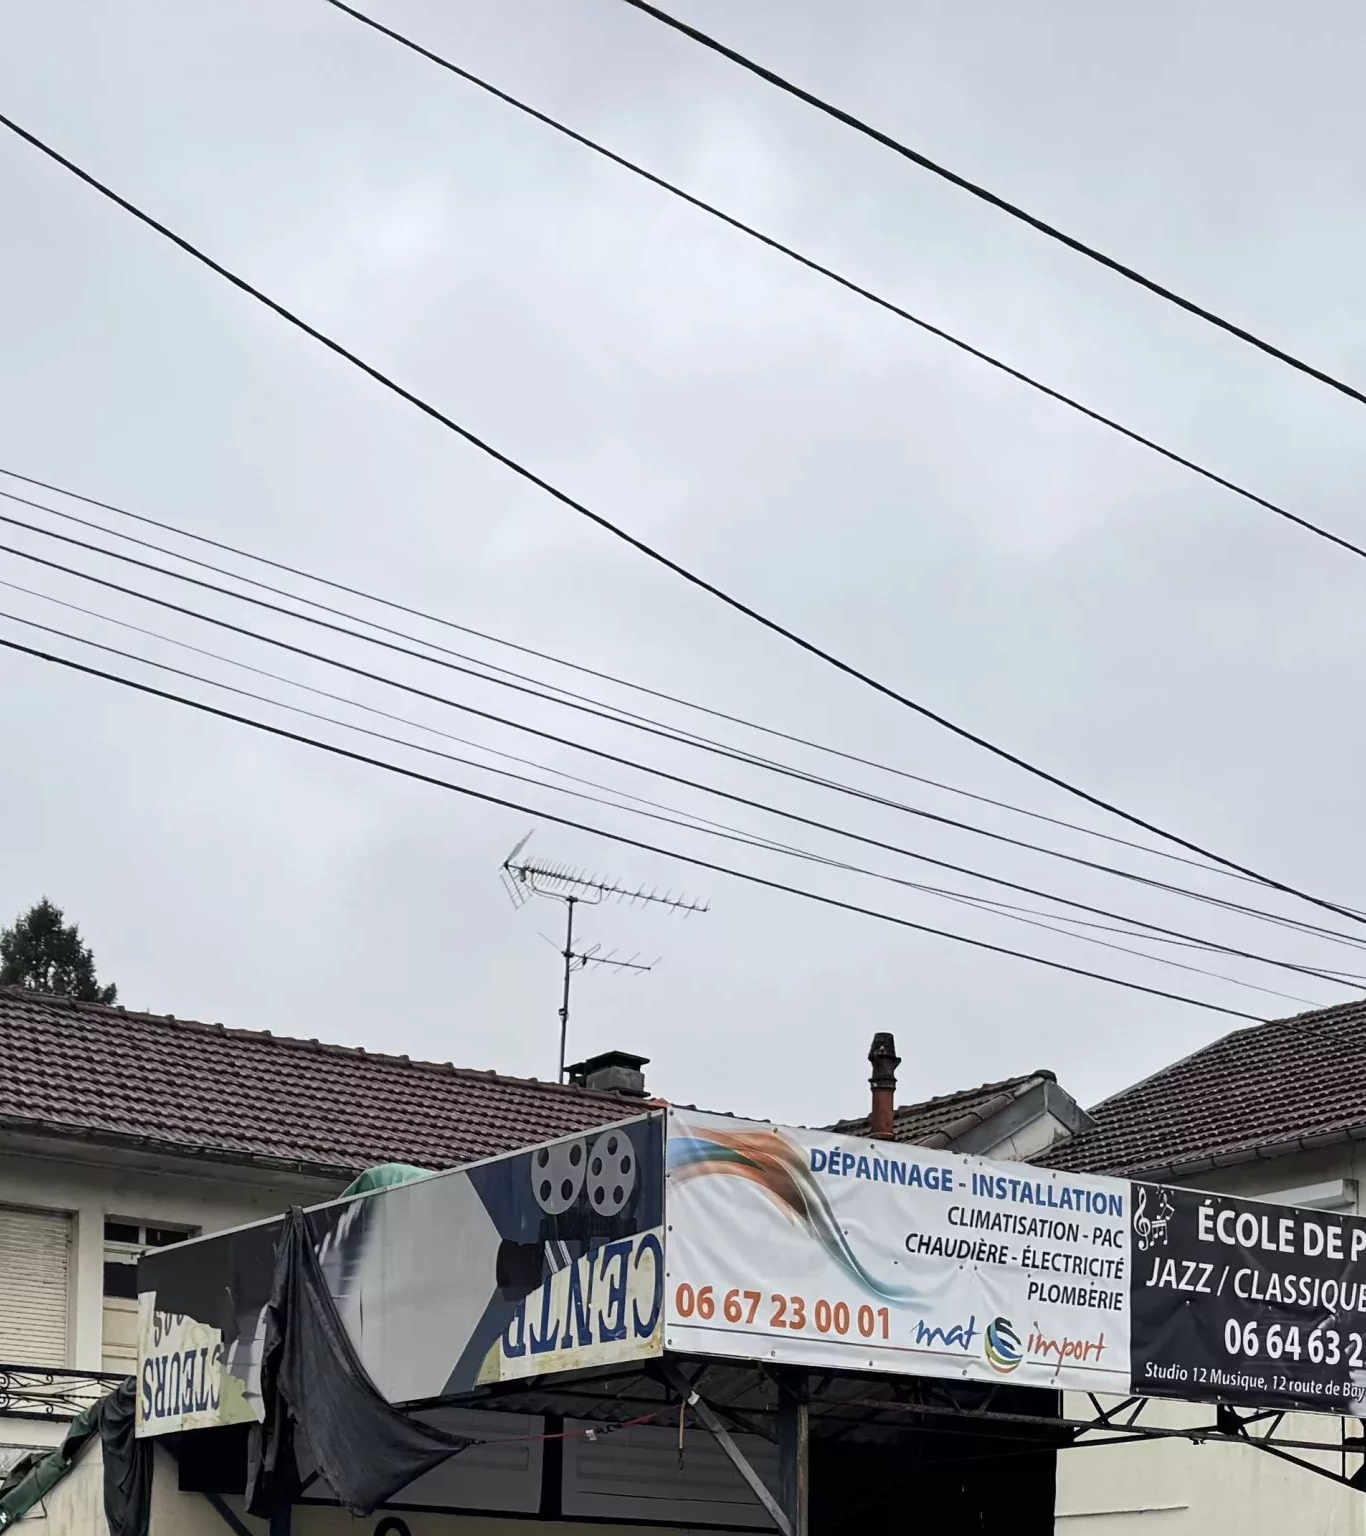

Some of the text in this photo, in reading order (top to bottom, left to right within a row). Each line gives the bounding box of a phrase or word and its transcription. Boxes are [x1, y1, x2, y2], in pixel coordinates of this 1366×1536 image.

[810, 1146, 953, 1192] DÉPANNAGE
[972, 1172, 1123, 1218] INSTALLATION
[947, 1206, 1079, 1244] CLIMATISATION
[1092, 1227, 1124, 1249] PAC
[1198, 1199, 1295, 1254] ÉCOLE
[1303, 1222, 1344, 1260] DE
[905, 1232, 1008, 1265] CHAUDIÈRE
[1021, 1245, 1124, 1280] ÉLECTRICITÉ
[1146, 1256, 1213, 1294] JAZZ
[1217, 1264, 1230, 1296] /
[675, 1283, 890, 1339] 06 67 23 00 01
[1027, 1282, 1123, 1311] PLOMBERIE
[911, 1315, 1107, 1375] mat import
[1224, 1318, 1259, 1357] 06
[1266, 1323, 1302, 1361] 64
[1307, 1327, 1341, 1366] 63
[1145, 1361, 1188, 1382] Studio
[1192, 1367, 1207, 1383] 12
[1209, 1369, 1268, 1391] Musique,
[1271, 1375, 1286, 1391] 12
[1288, 1378, 1322, 1395] route
[1324, 1379, 1341, 1396] de
